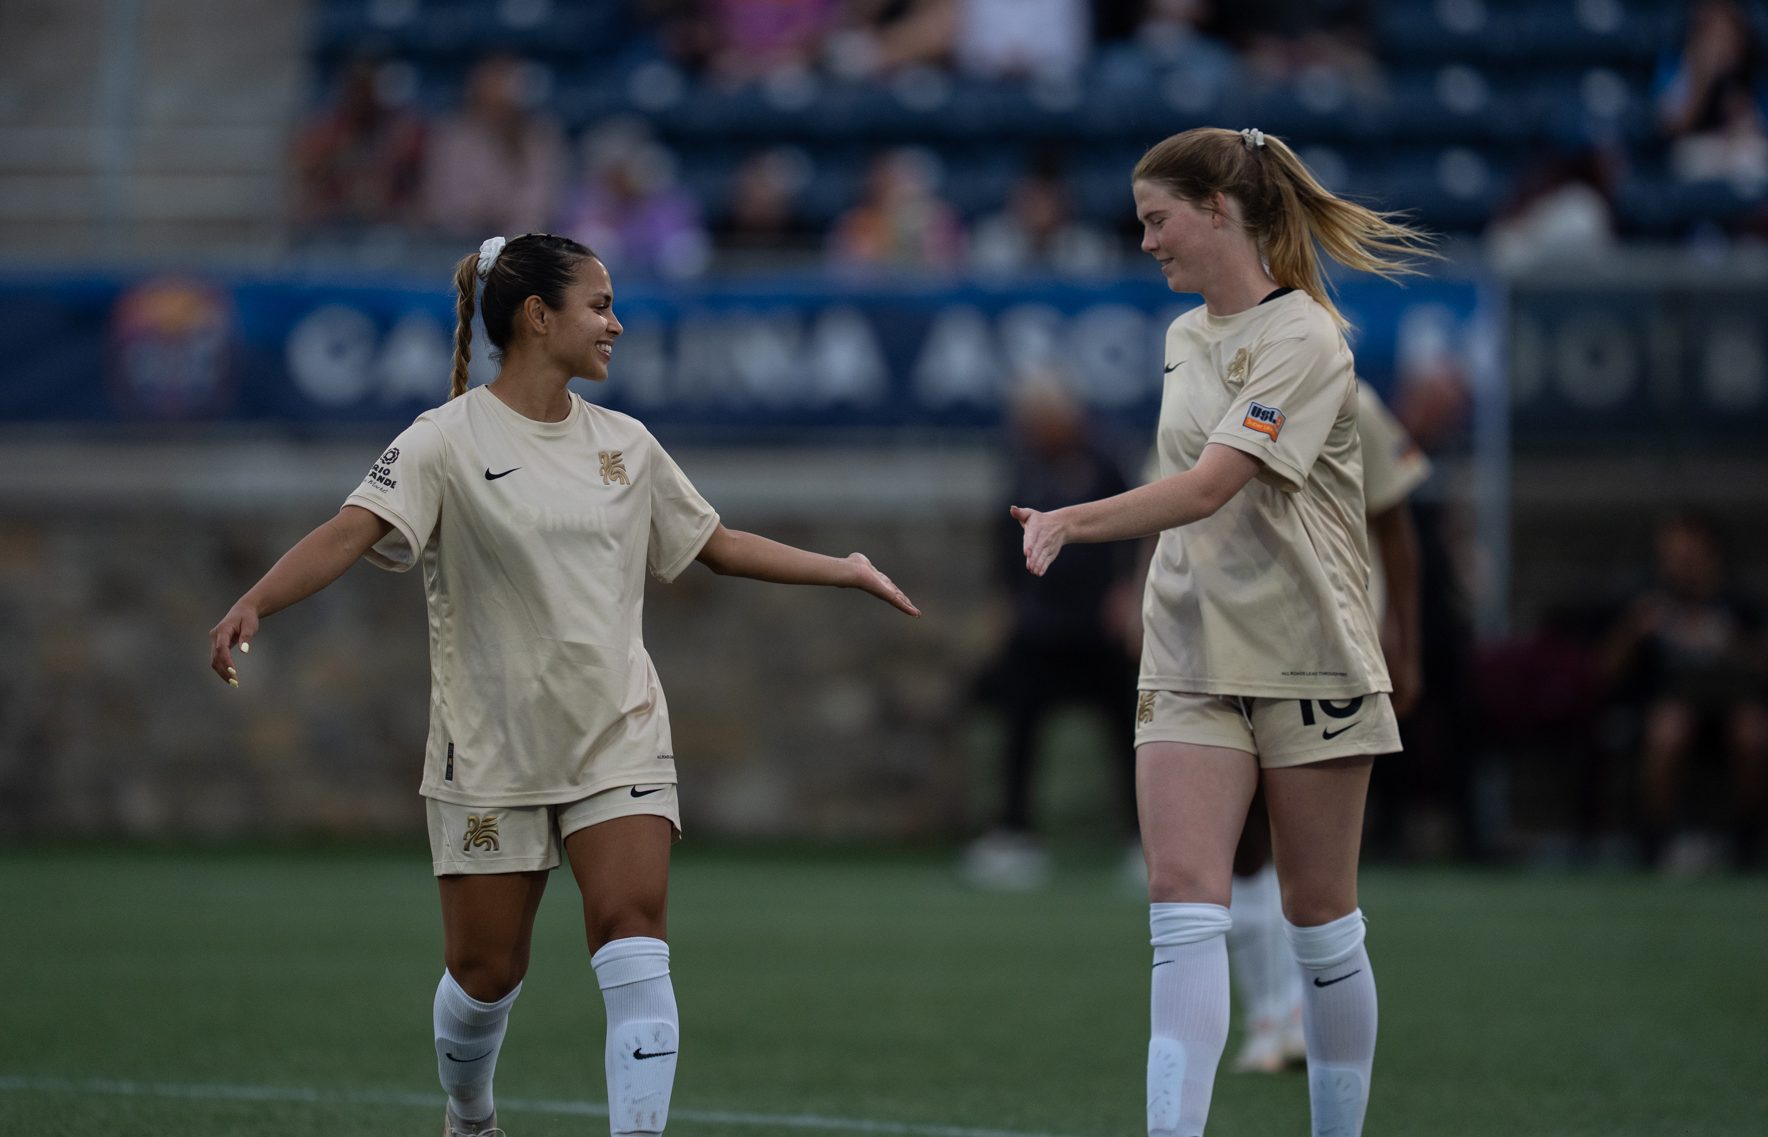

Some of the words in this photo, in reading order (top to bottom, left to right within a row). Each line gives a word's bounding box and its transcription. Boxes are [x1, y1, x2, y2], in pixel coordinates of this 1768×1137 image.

[1251, 405, 1276, 424] USL
[372, 464, 391, 476] RIO
[368, 471, 397, 489] ANDE
